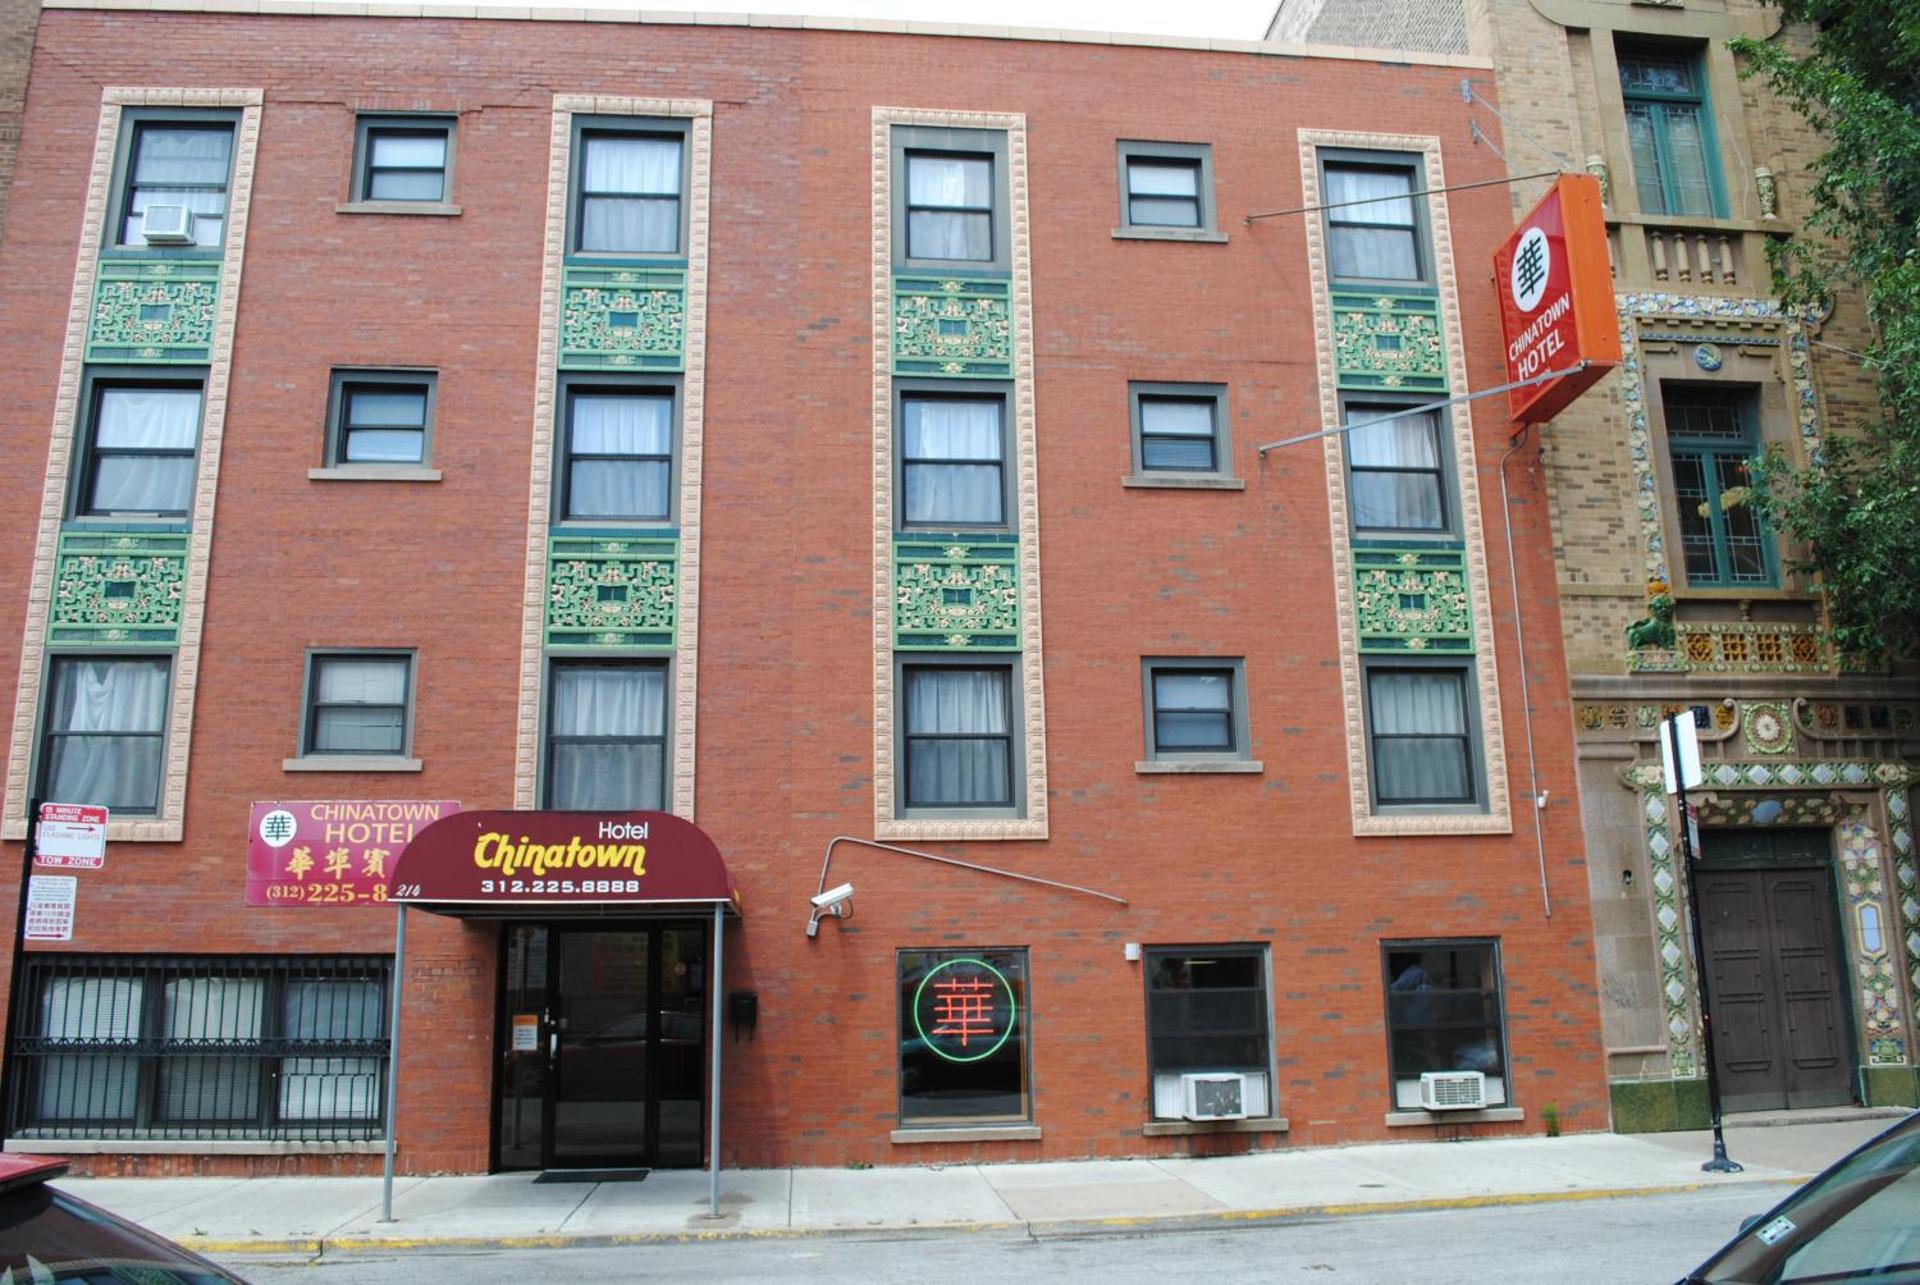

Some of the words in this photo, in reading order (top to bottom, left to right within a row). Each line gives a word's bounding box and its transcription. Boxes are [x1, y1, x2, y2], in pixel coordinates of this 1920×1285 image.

[1509, 292, 1570, 362] CHINATOWN
[1518, 328, 1565, 382] HOTEL
[45, 813, 79, 821] STANDING
[82, 815, 100, 823] ZONE
[56, 806, 82, 815] MINUTE
[311, 804, 439, 821] CHINATOWN
[598, 821, 648, 839] Hotel
[40, 856, 62, 865] TOW
[68, 857, 96, 866] ZONE
[474, 832, 646, 876] Chinatown
[266, 885, 305, 901] (312)
[307, 883, 388, 902] 225-8
[481, 880, 639, 893] 312.225.8888
